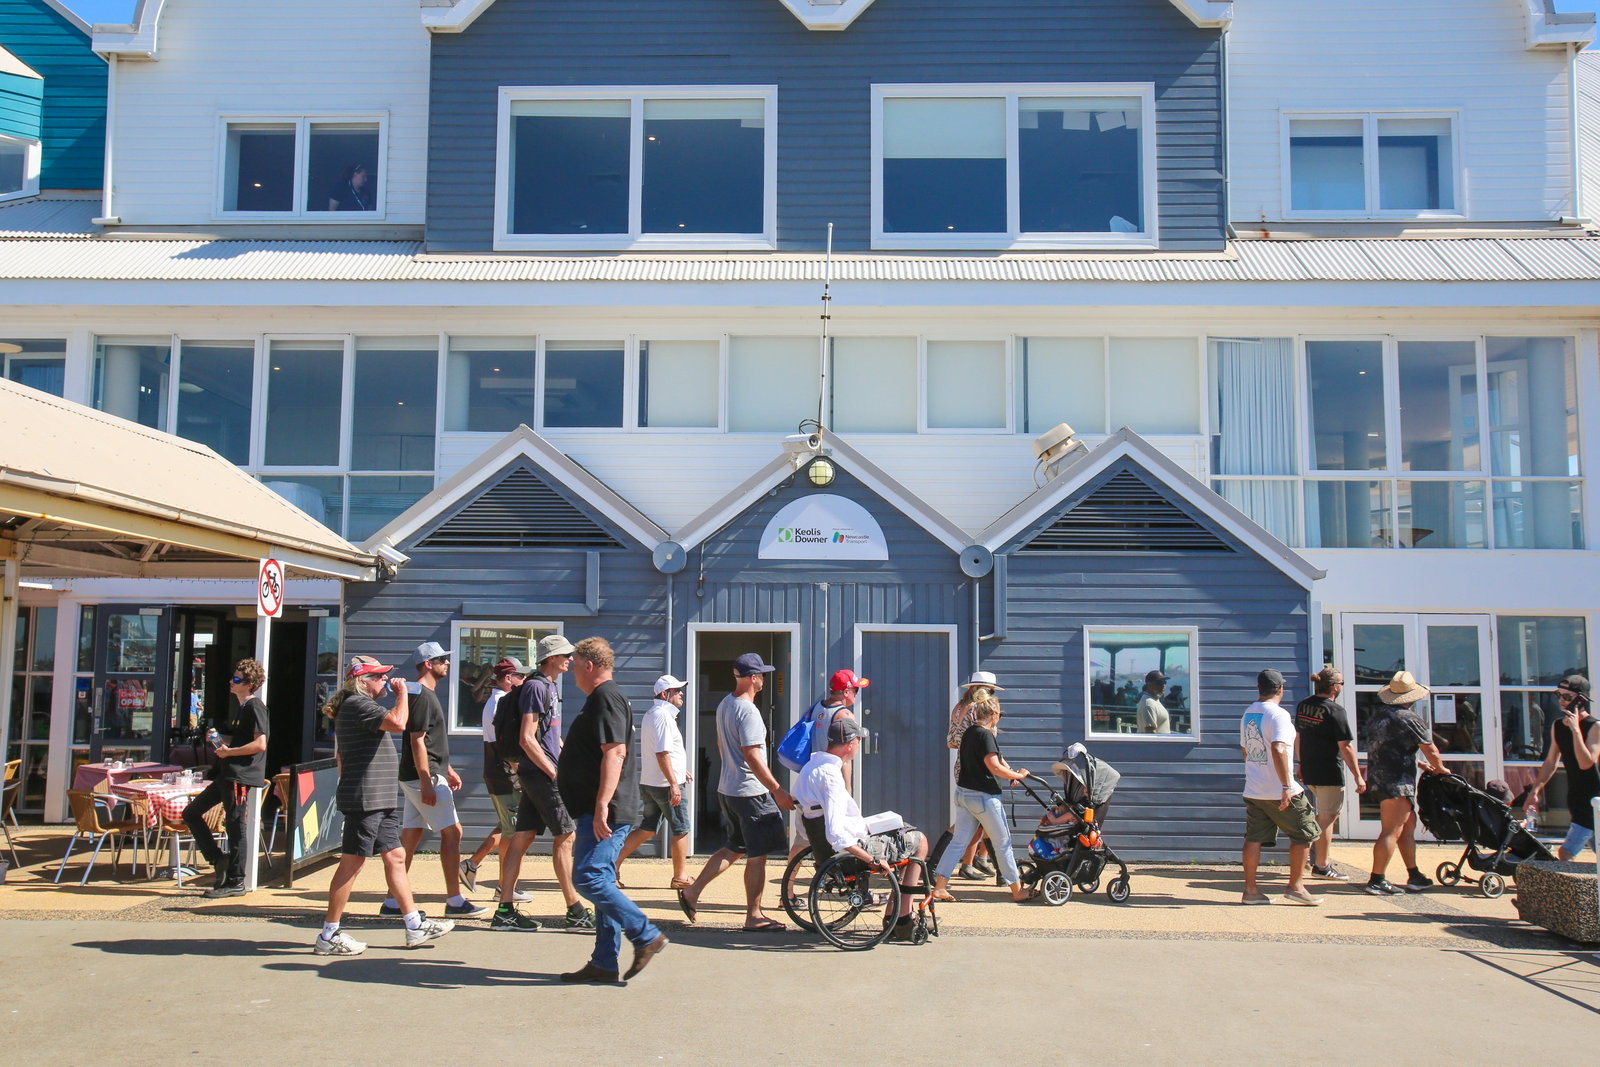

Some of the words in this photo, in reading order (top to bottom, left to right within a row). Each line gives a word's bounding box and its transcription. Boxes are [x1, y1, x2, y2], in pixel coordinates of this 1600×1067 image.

[795, 528, 821, 536] Keolis
[795, 535, 828, 543] Downer
[121, 698, 144, 706] OPEN
